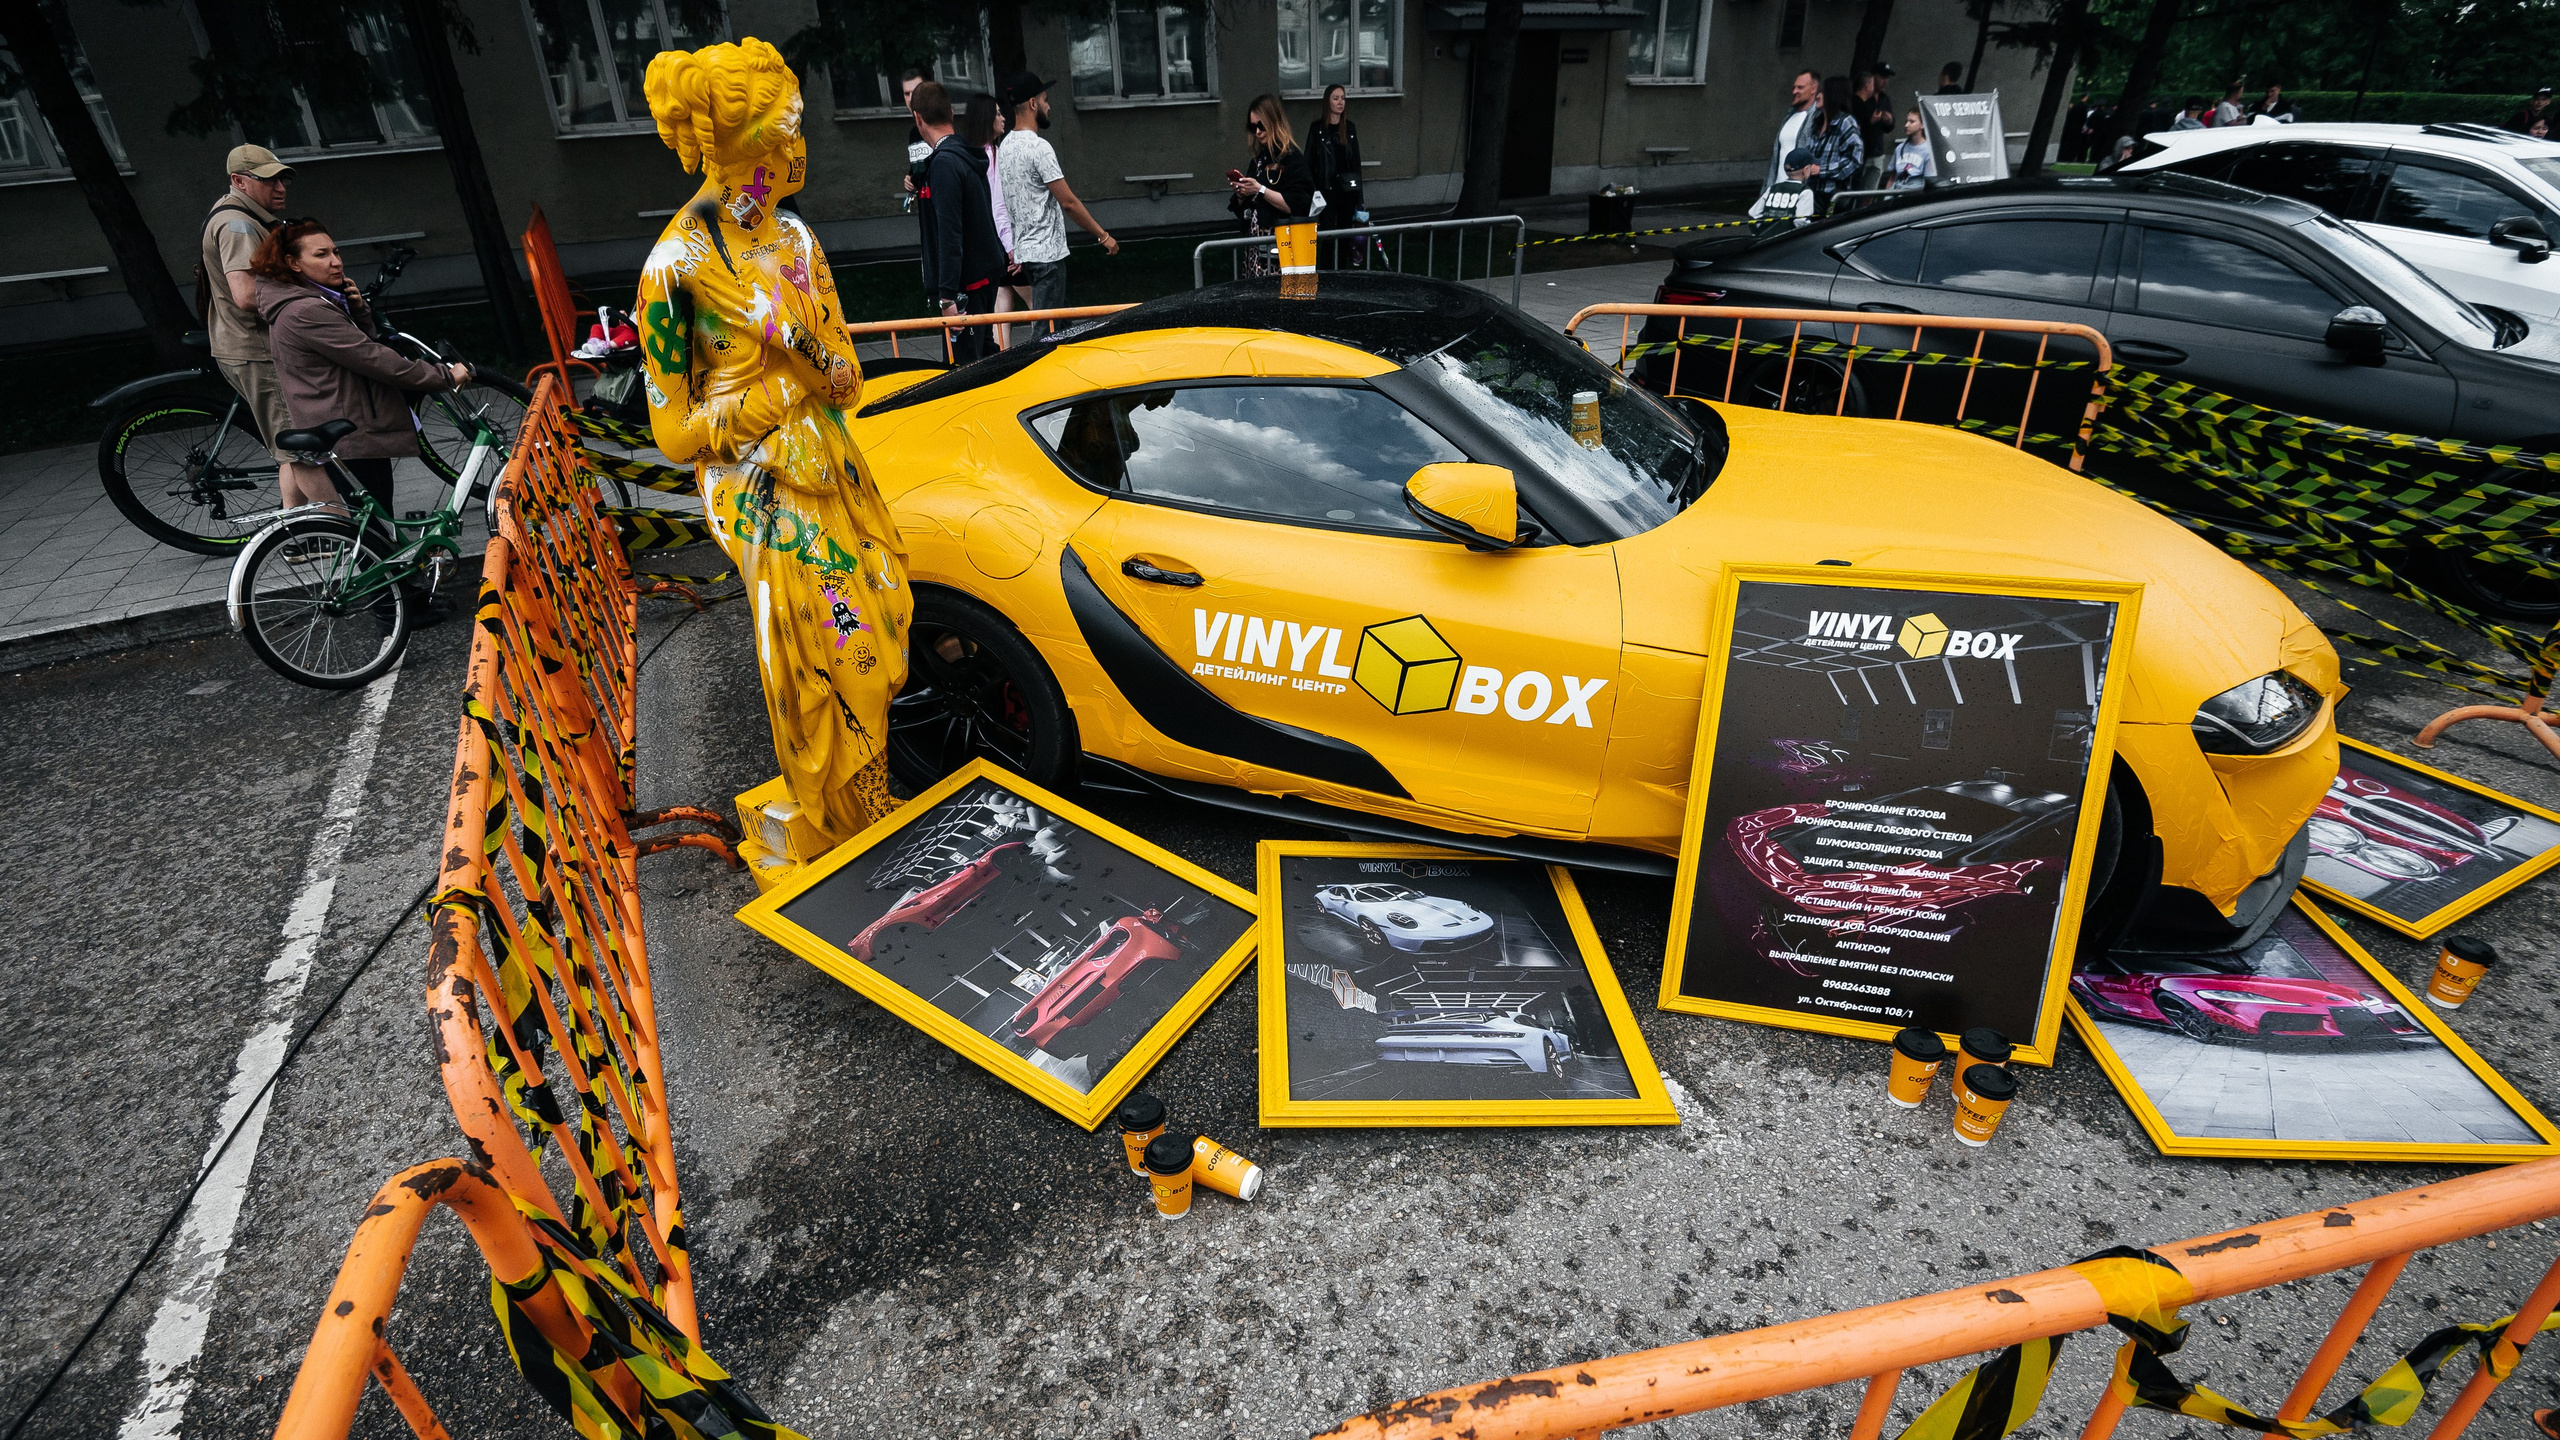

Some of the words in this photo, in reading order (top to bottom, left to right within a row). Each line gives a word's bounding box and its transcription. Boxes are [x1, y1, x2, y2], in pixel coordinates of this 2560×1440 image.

[1934, 102, 1952, 117] TOP
[1952, 100, 1991, 117] SERVICE
[720, 185, 733, 205] 2024
[792, 273, 806, 284] LOVE
[115, 408, 169, 454] WAYTOWN
[1803, 638, 1859, 649] ДЕТЕЙЛИНГ
[1860, 640, 1891, 651] ЦЕНТР
[1808, 610, 1896, 642] VINYL
[1945, 630, 2024, 661] BOX
[1192, 662, 1287, 687] ДЕТЕЙЛИНГ
[1291, 676, 1346, 695] ЦЕНТР
[1193, 608, 1351, 679] VINYL
[1454, 665, 1609, 729] BOX
[1825, 800, 1904, 816] БРОНИРОВАНИЕ
[1906, 808, 1946, 820] КУЗОВА
[1794, 816, 1872, 832] БРОНИРОВАНИЕ
[1874, 824, 1930, 838] ЛОБОВОГО
[1933, 830, 1972, 842] СТЕКЛА
[1816, 837, 1900, 854] ШУМОИЗОЛЯЦИЯ
[1903, 846, 1943, 859] КУЗОВА
[1358, 862, 1401, 873] VINYL
[1428, 865, 1471, 877] BOX
[1803, 856, 1843, 869] ЗАЩИТА
[1846, 861, 1905, 876] ЭЛЕМЕНТОВ
[1823, 880, 1869, 893] ОКЛЕЙКА
[1871, 885, 1922, 898] ВИНИЛОМ
[1794, 896, 1862, 912] РЕСТАВРАЦИЯ
[1864, 904, 1871, 913] И
[1873, 905, 1914, 918] РЕМОНТ
[1916, 910, 1946, 921] КОЖИ
[1783, 914, 1840, 929] УСТАНОВКА
[1841, 921, 1867, 932] ДОП.
[1869, 924, 1950, 942] ОБОРУДОВАНИЯ
[1836, 941, 1890, 954] АНТИХРОМ
[1769, 950, 1837, 967] ВЫПРАВЛЕНИЕ
[1840, 959, 1878, 972] ВМЯТИН
[1880, 964, 1897, 975] БЕЗ
[1900, 967, 1953, 982] ПОКРАСКИ
[1823, 979, 1890, 996] 89682463888
[1356, 987, 1378, 1014] BOX
[1797, 996, 1812, 1006] ул.
[1815, 998, 1882, 1015] Октябрьская
[1884, 1007, 1913, 1019] 108/1
[1959, 1101, 1987, 1121] OFFEE
[1172, 1181, 1190, 1195] BOX
